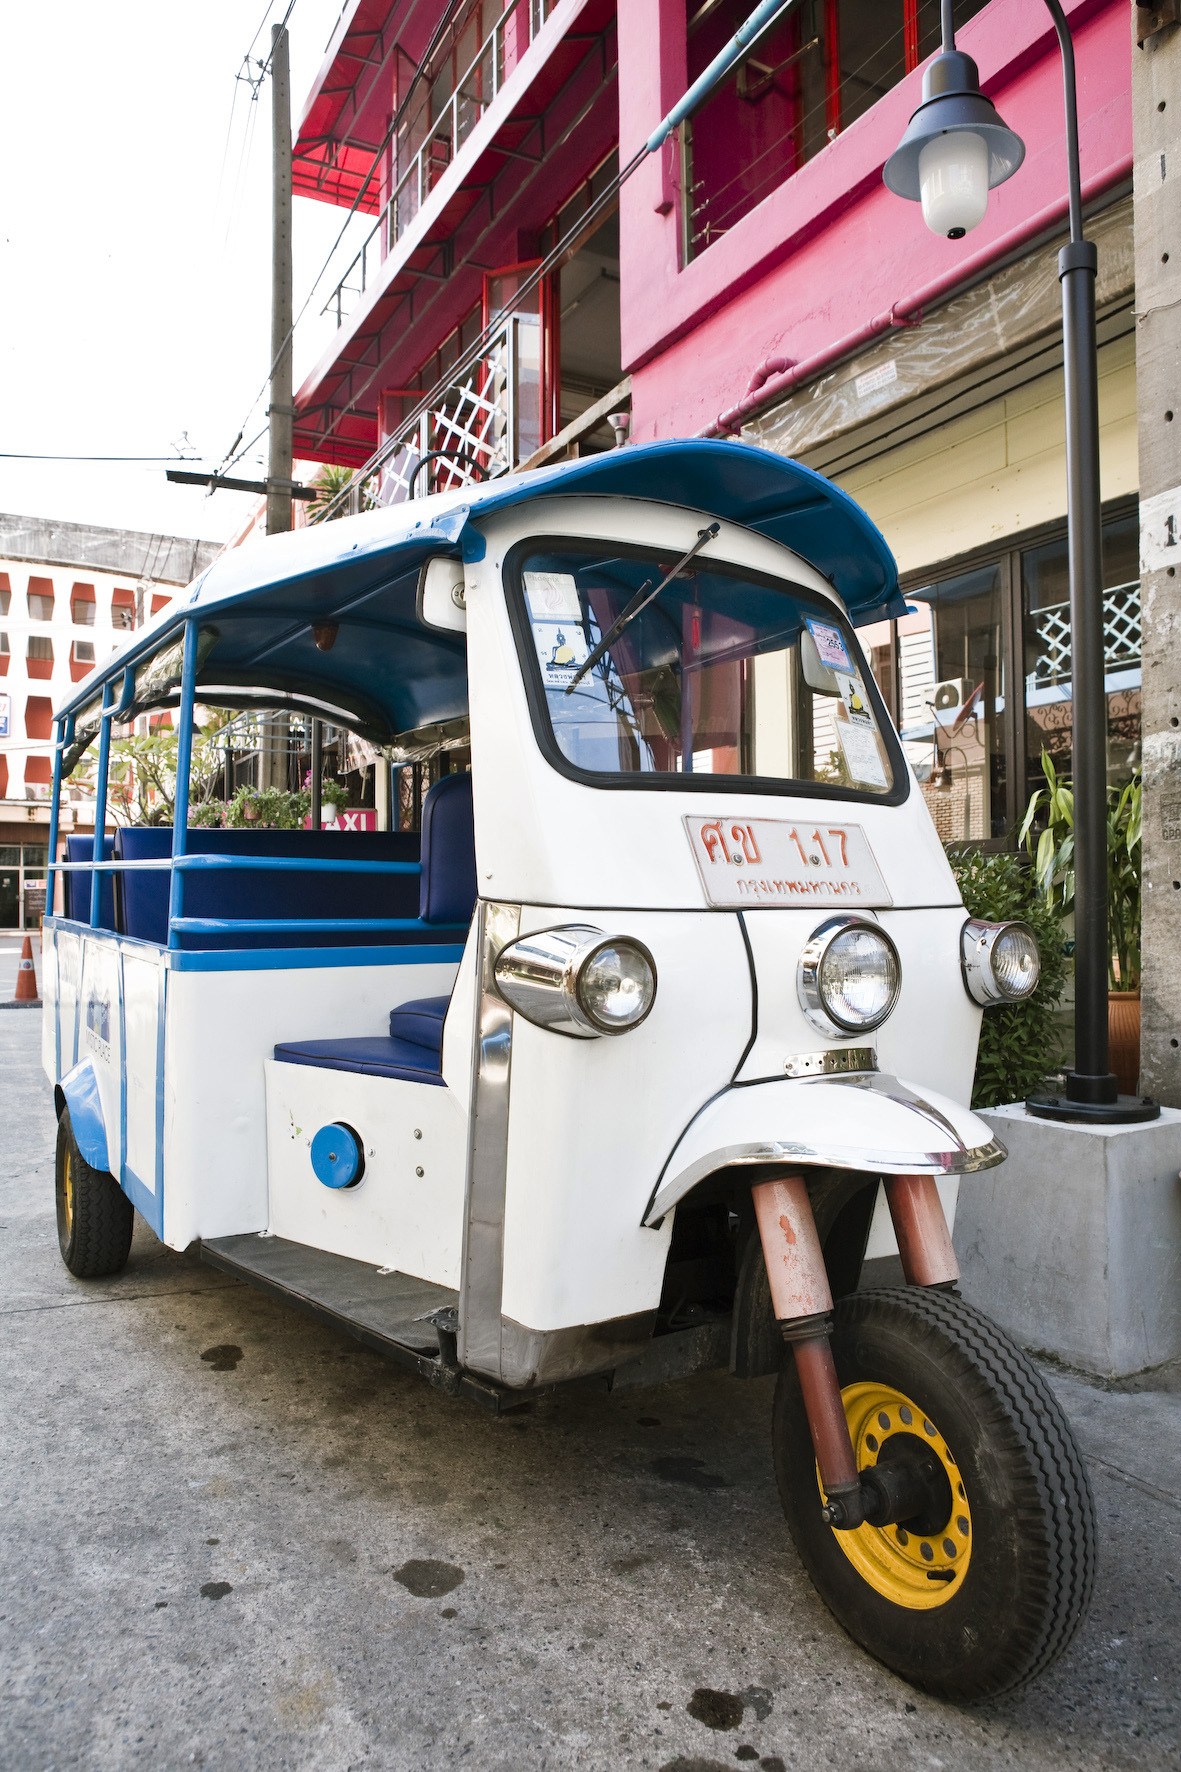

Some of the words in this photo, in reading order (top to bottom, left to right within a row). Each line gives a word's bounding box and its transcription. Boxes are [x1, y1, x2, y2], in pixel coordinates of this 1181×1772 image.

[325, 813, 367, 831] AXI
[736, 879, 861, 900] กรุงเทพมหานคร
